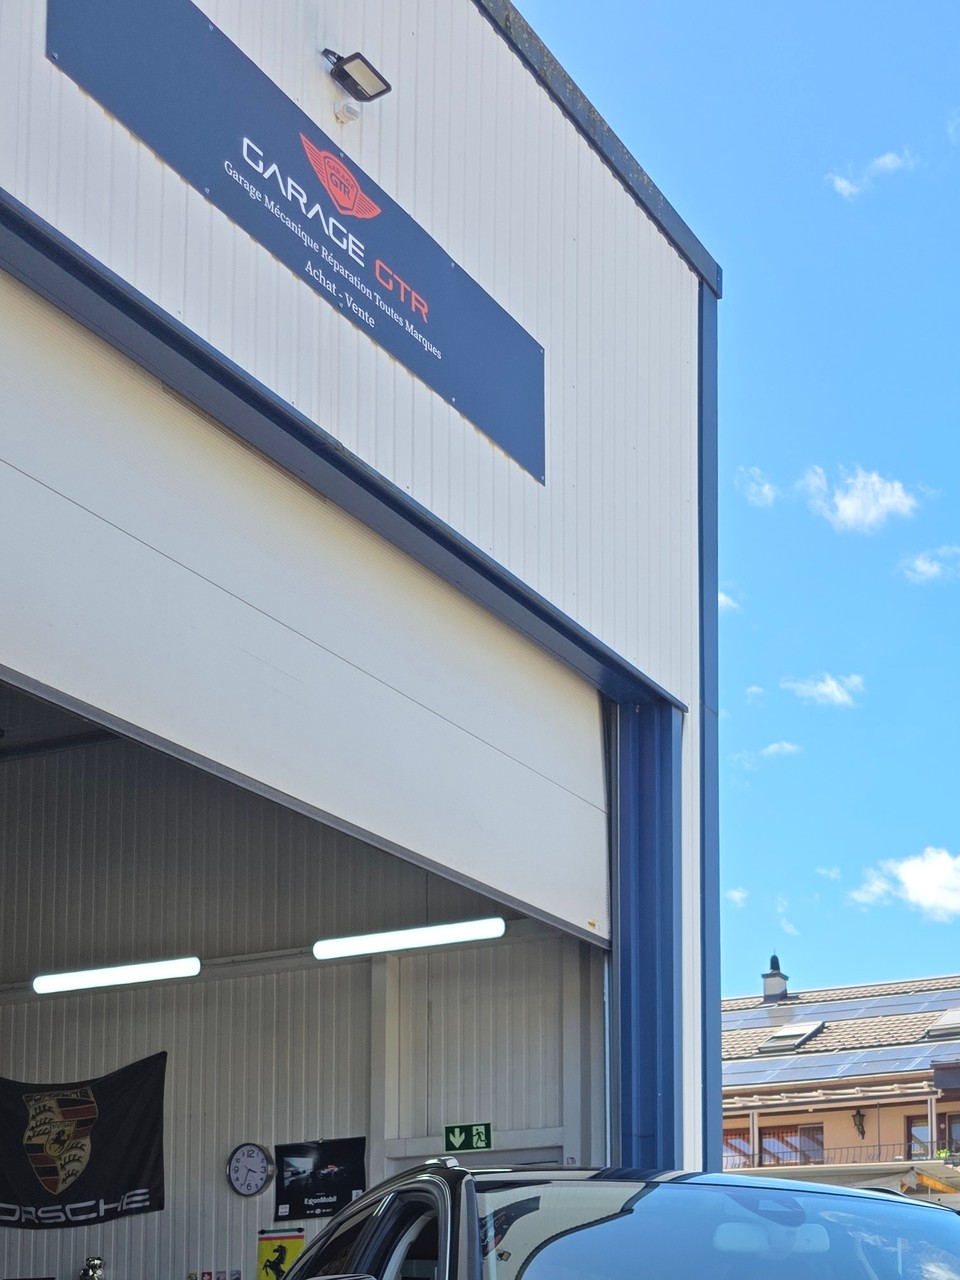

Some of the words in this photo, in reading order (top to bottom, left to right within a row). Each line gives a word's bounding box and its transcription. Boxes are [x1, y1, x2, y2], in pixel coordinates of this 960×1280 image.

[330, 172, 351, 200] GTR
[224, 160, 262, 202] Garage
[263, 194, 319, 252] Mécanique
[321, 245, 373, 300] Réparation
[373, 292, 404, 327] Toutes
[405, 319, 442, 360] Marques
[242, 137, 365, 267] GARAGE
[374, 259, 428, 323] GTR
[304, 260, 337, 297] Achat
[344, 292, 376, 328] Vente
[0, 1188, 151, 1223] ORSCHE
